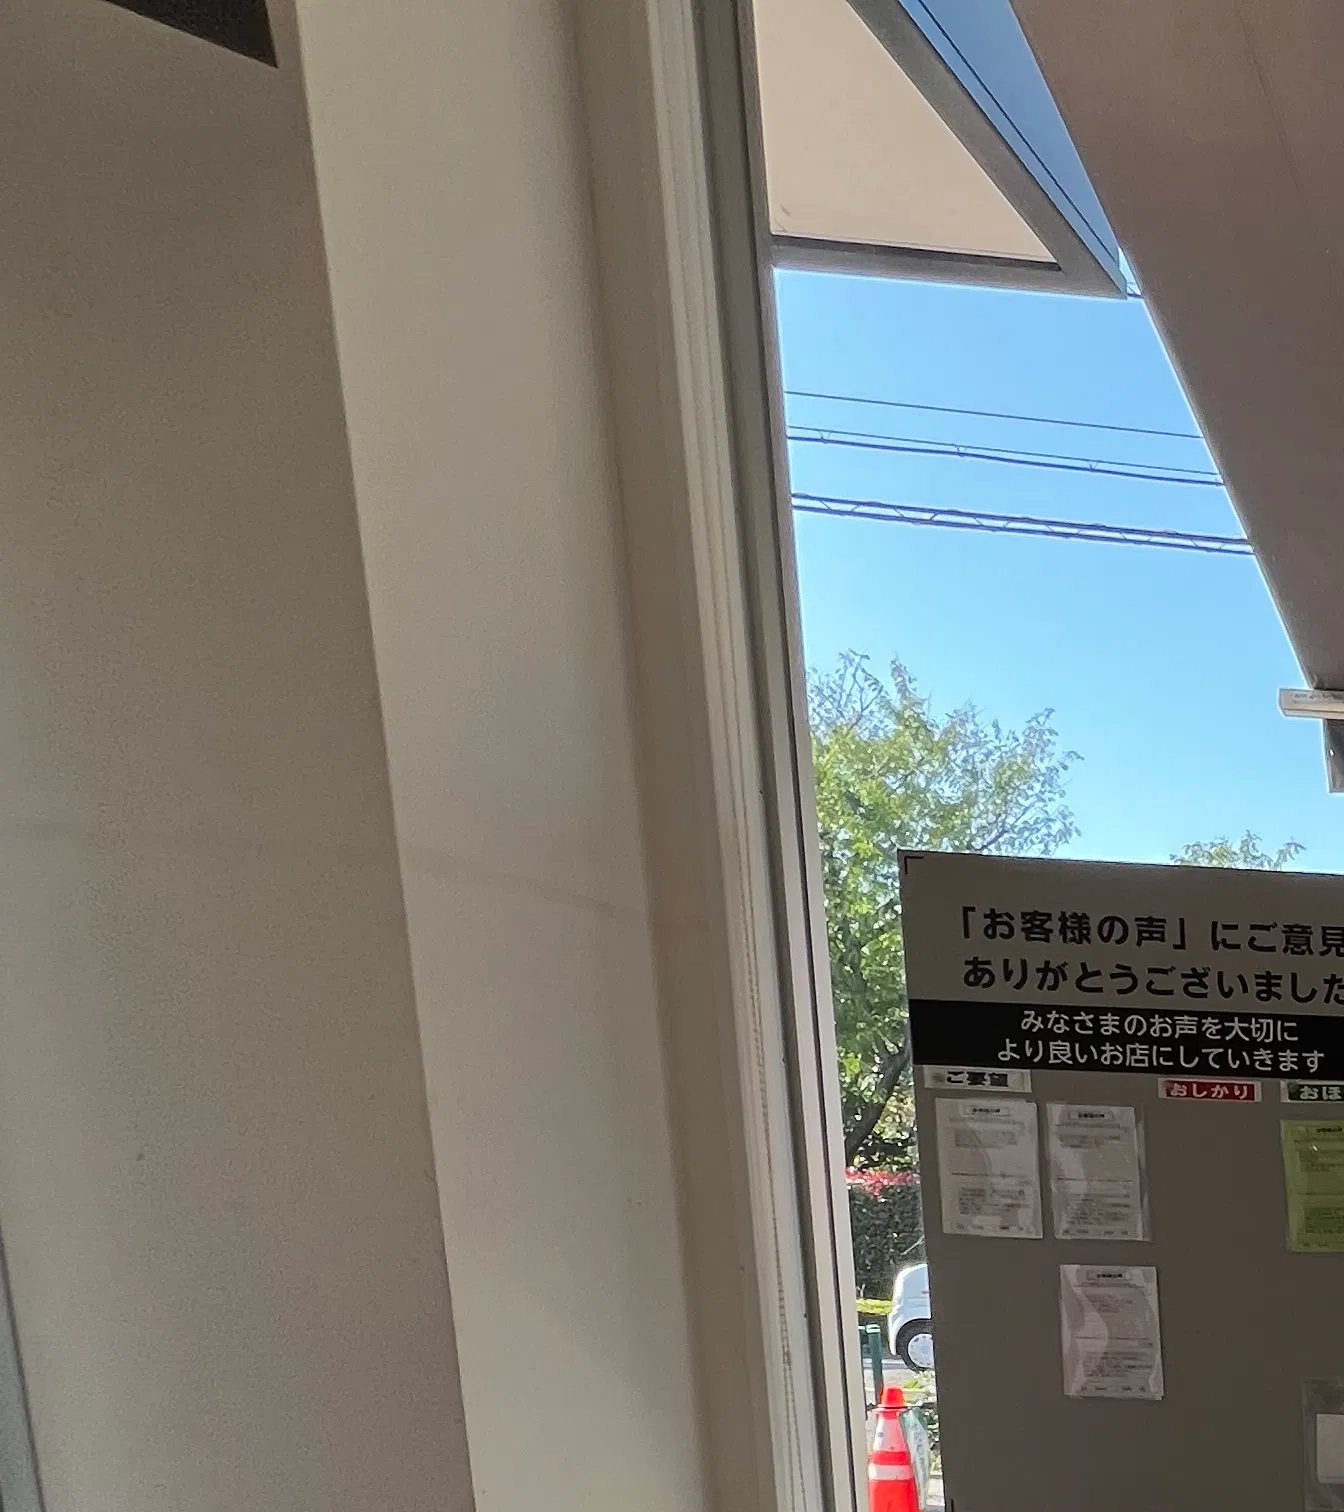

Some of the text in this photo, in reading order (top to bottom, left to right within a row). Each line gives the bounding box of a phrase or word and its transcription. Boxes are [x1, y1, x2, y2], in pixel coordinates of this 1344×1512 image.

[1020, 1010, 1299, 1043] みなさまのお声を大切に
[997, 1038, 1325, 1074] より良いお店にしていきます
[1170, 1082, 1248, 1099] おしかり
